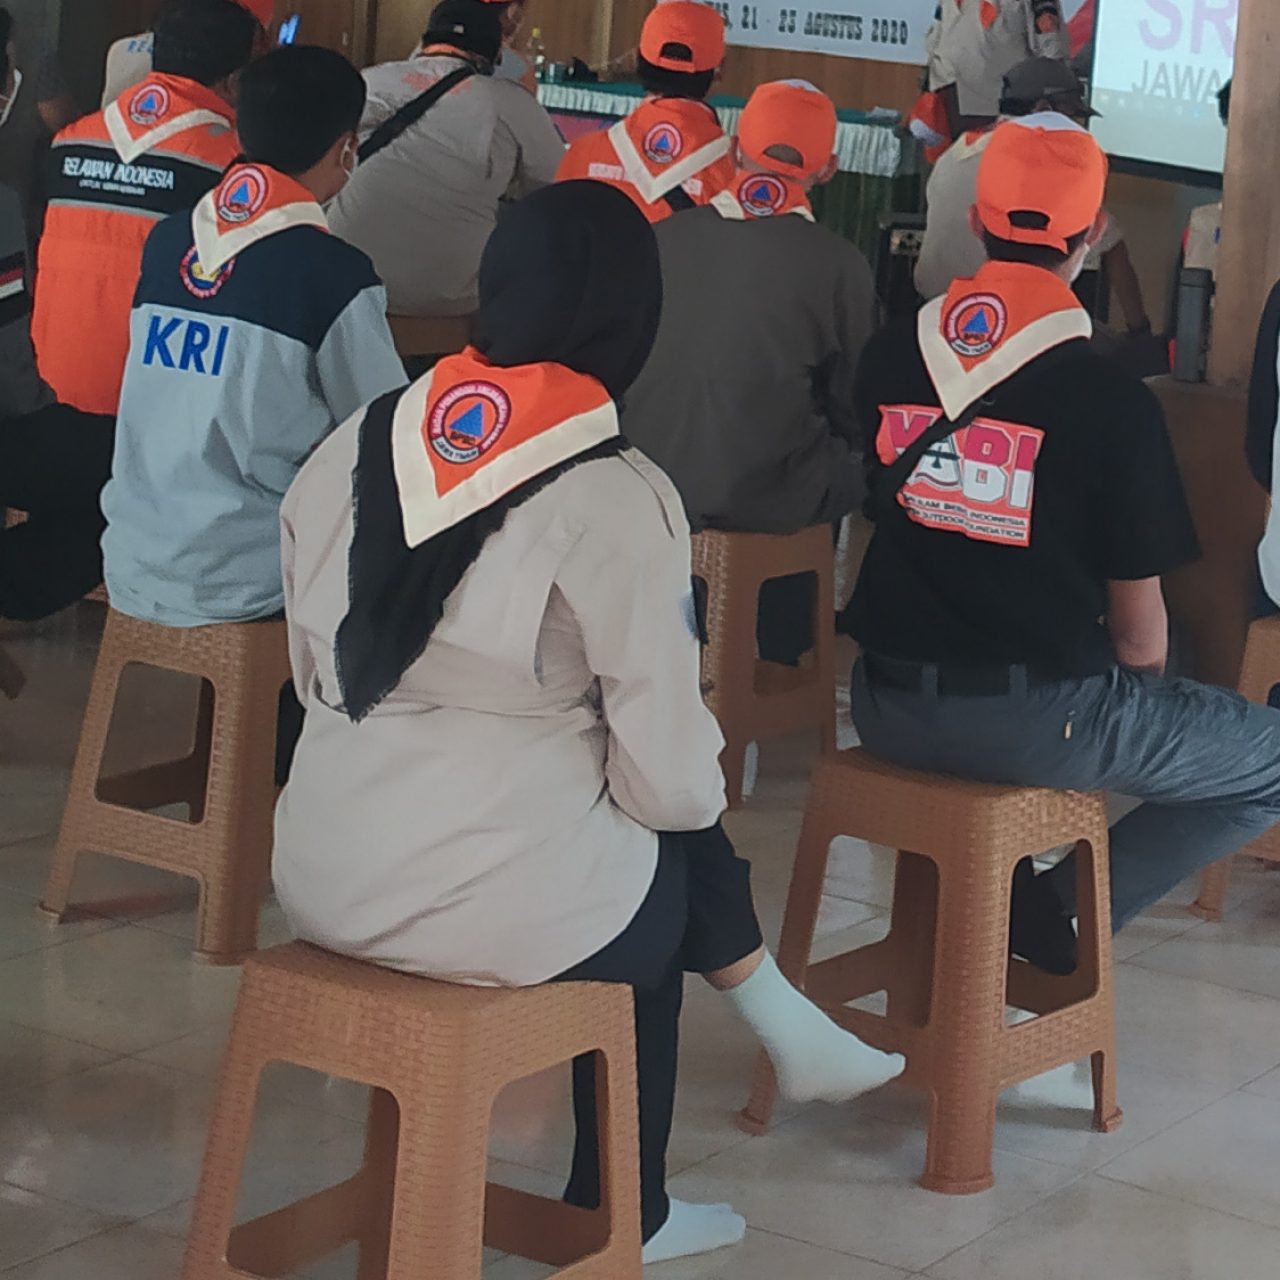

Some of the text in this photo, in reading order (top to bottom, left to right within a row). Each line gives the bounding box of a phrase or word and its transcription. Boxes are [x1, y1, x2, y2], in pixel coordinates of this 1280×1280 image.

[742, 4, 757, 30] 21
[803, 11, 863, 41] AGUSTUS
[871, 18, 909, 46] 2020
[62, 156, 116, 180] RELAWAN
[112, 163, 175, 191] INDONESIA
[143, 315, 230, 377] KRI
